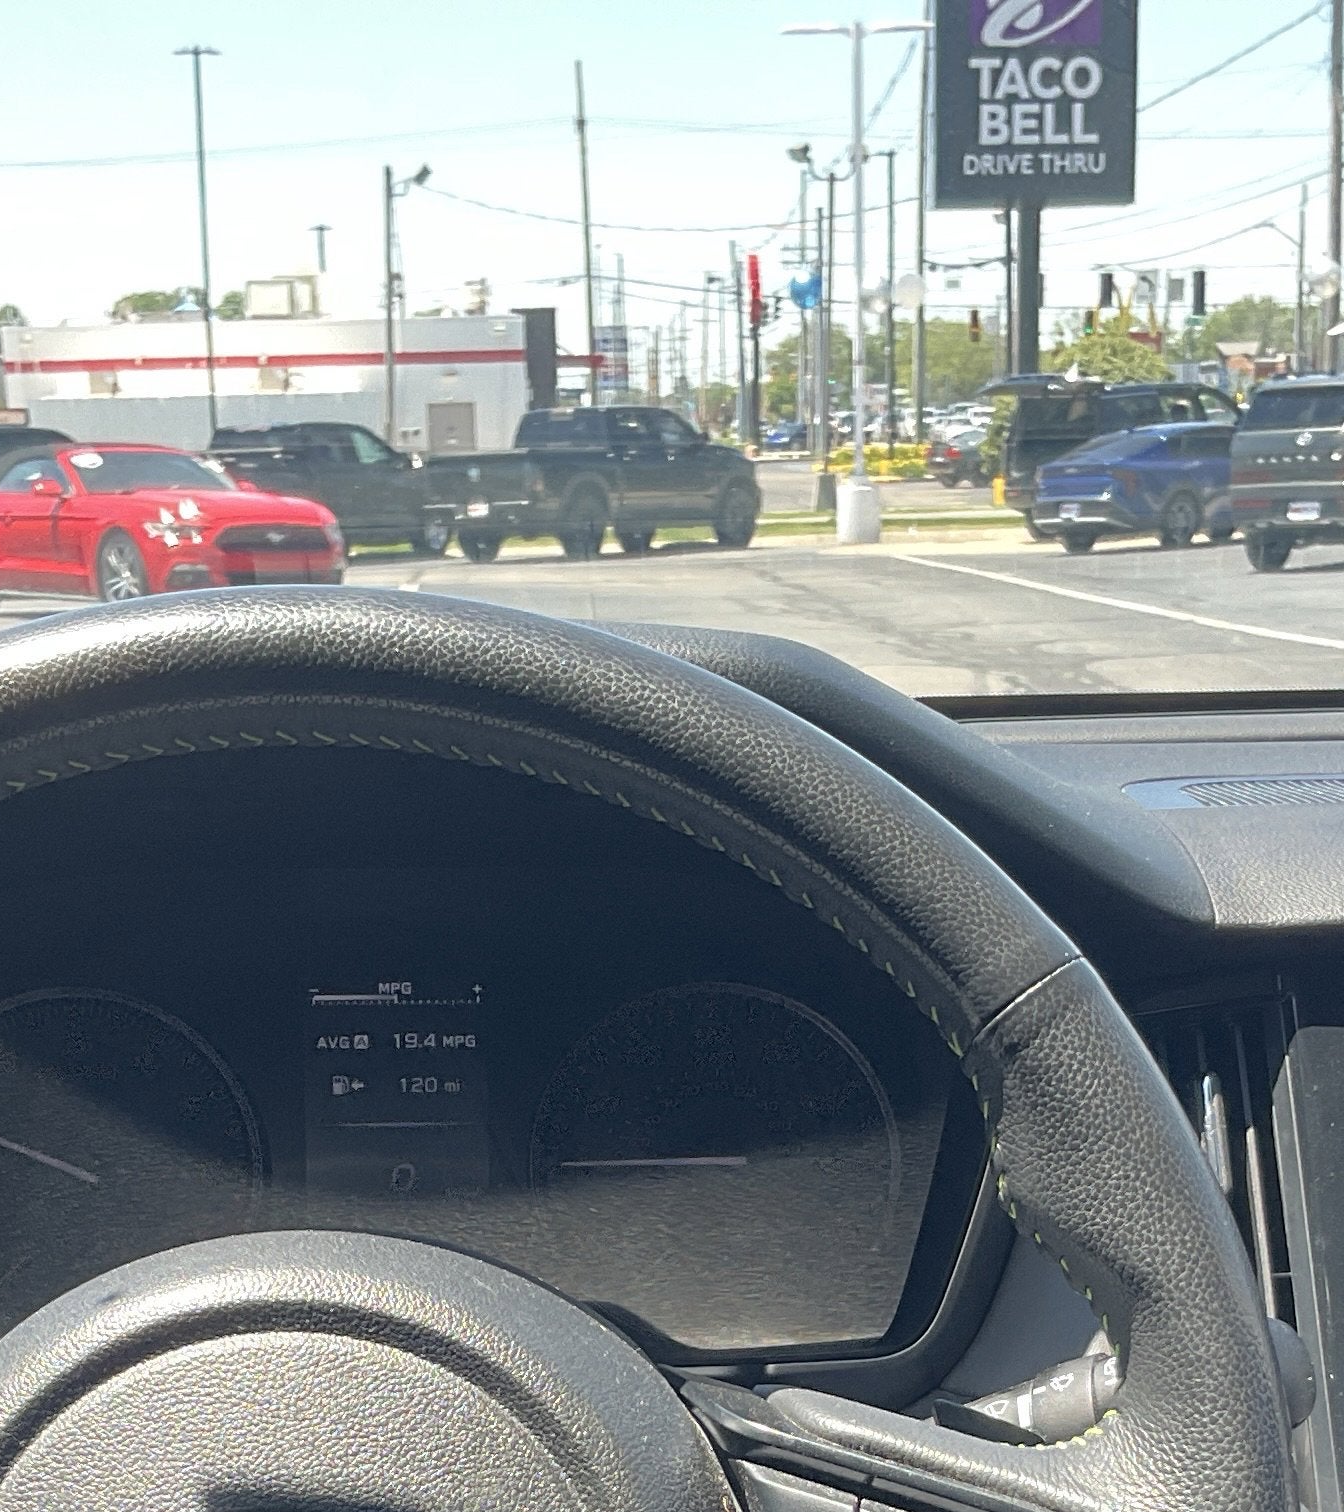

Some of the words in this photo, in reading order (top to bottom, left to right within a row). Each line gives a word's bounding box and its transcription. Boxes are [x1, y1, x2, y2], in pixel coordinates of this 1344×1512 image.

[968, 56, 1103, 99] TACO
[978, 103, 1100, 145] BELL
[963, 153, 1035, 175] DRIVE
[1038, 152, 1106, 174] THRU
[378, 982, 412, 995] MPG
[316, 1036, 350, 1049] AVG
[393, 1032, 436, 1050] 19.4
[442, 1034, 477, 1048] MPG
[399, 1077, 438, 1093] 120
[444, 1080, 462, 1093] mi
